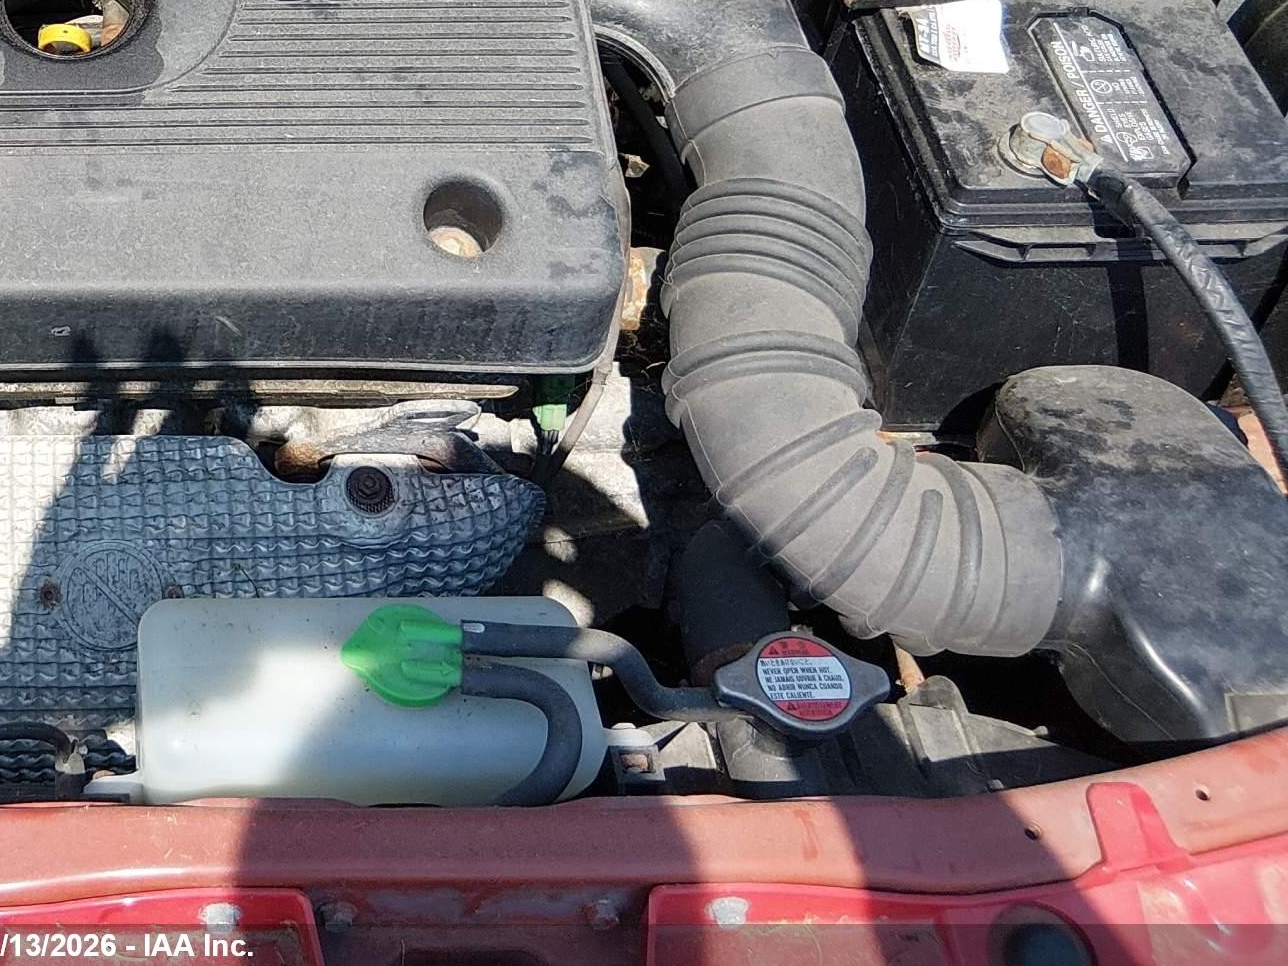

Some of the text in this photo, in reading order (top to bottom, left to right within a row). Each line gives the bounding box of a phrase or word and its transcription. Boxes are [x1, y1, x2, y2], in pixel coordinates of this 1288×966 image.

[1050, 41, 1080, 80] POISON
[1075, 89, 1109, 134] DANGER
[762, 668, 782, 676] NEVER
[783, 667, 799, 675] OPEN
[800, 666, 818, 674] WHEN
[767, 684, 777, 692] NO
[819, 682, 843, 690] CUANDO
[770, 692, 785, 700] ESTE
